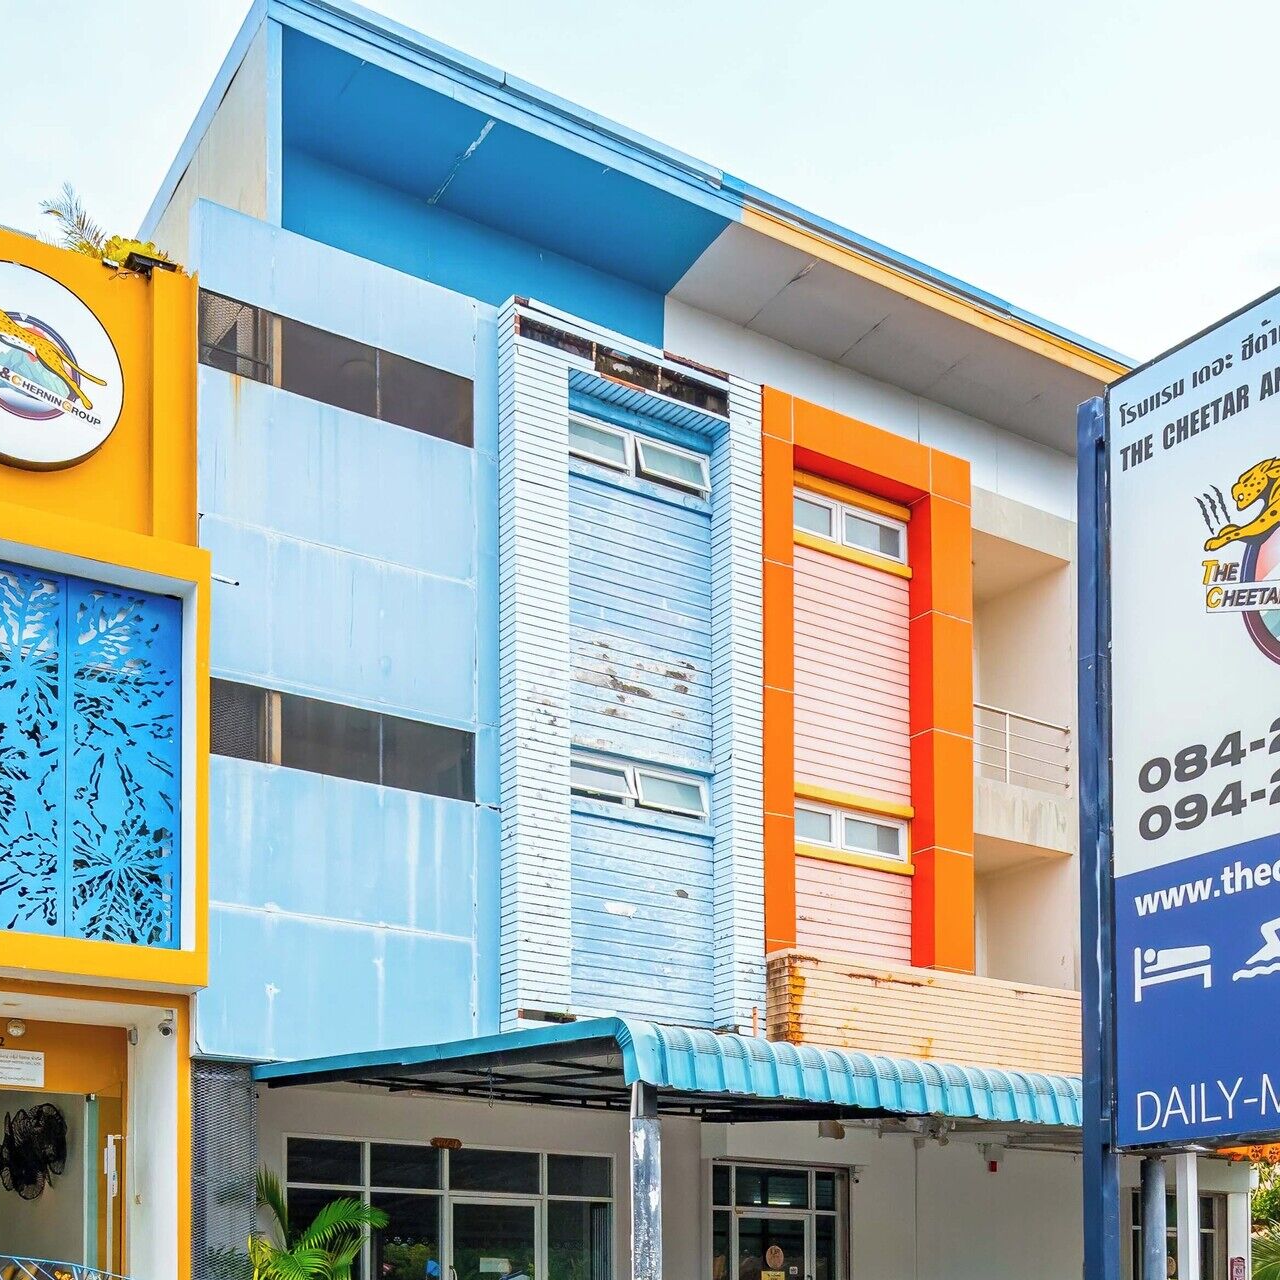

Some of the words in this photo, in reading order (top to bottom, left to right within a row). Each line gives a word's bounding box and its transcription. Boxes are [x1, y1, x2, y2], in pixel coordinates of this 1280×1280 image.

[1119, 379, 1185, 427] โรงแรม
[1192, 354, 1233, 388] เดอะ
[1120, 434, 1154, 472] THE
[1162, 384, 1249, 449] CHEETAR
[1202, 559, 1239, 585] THE
